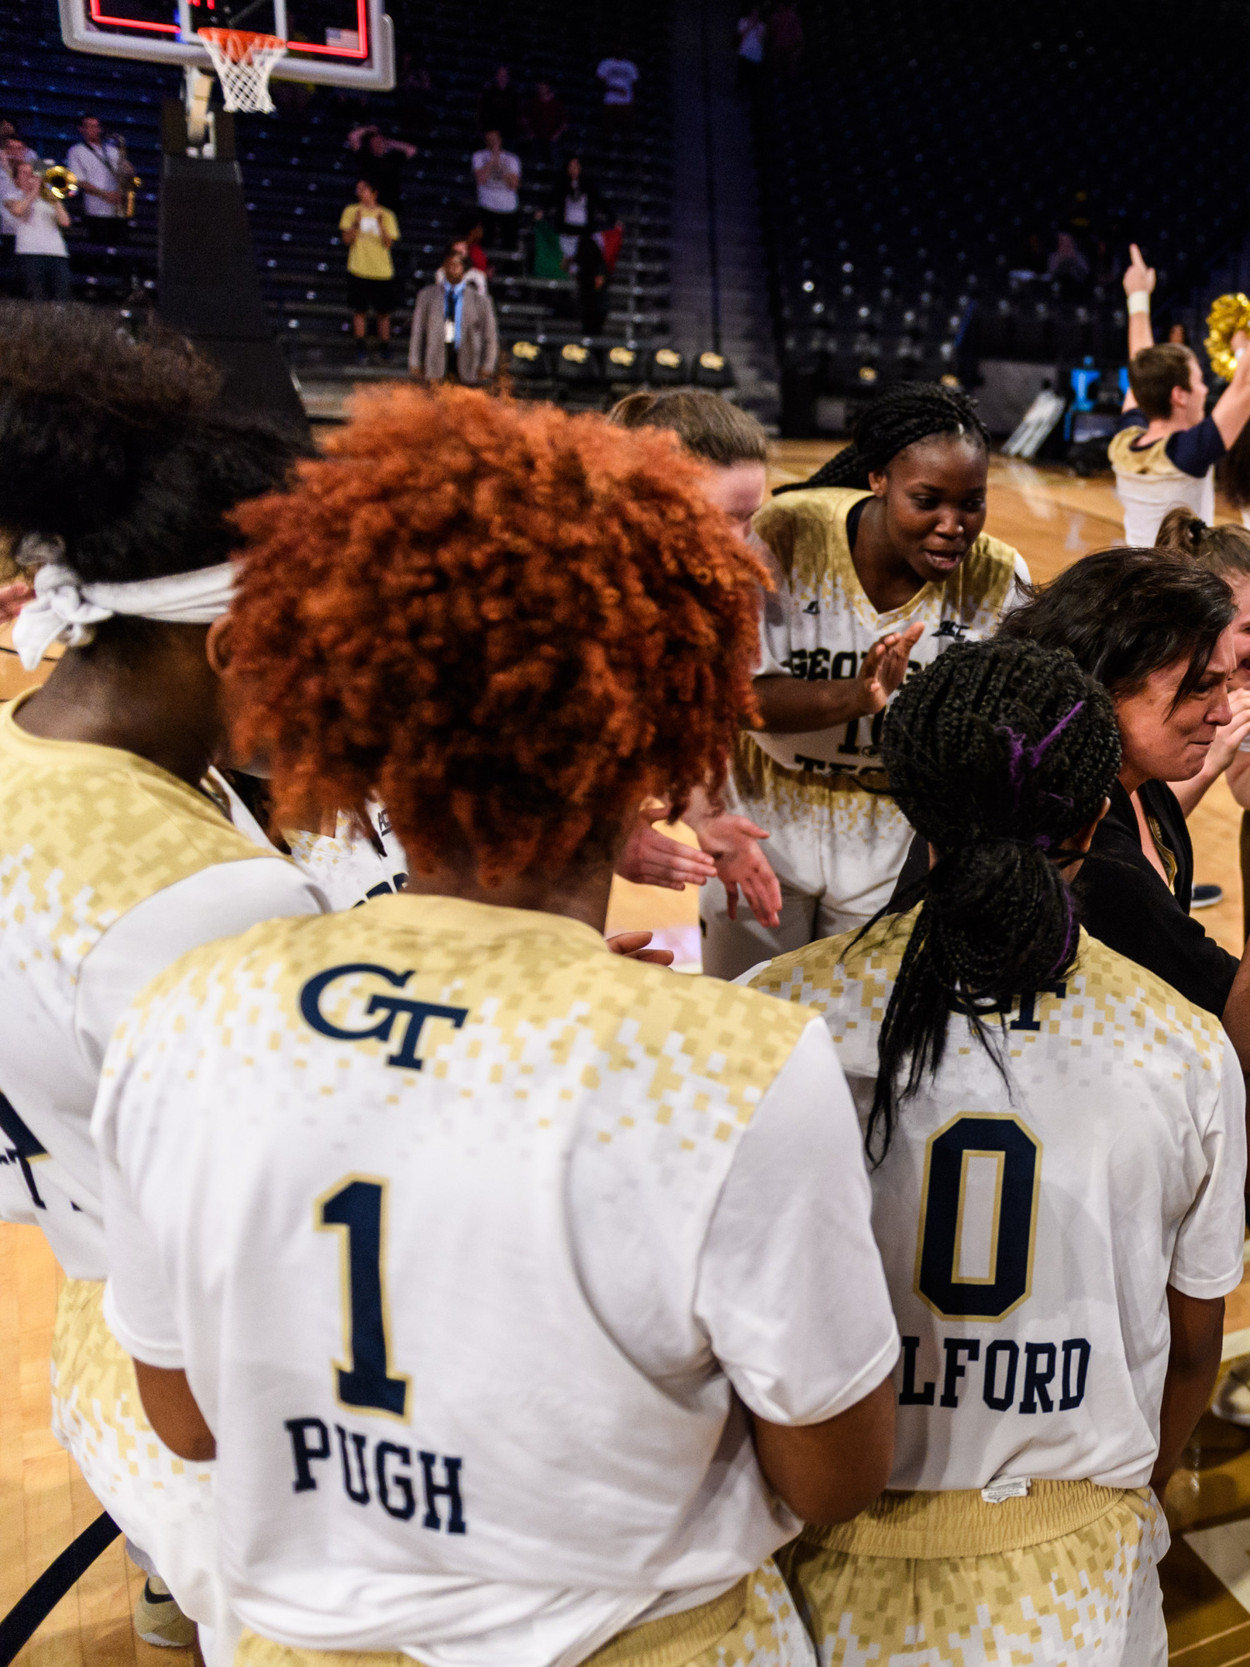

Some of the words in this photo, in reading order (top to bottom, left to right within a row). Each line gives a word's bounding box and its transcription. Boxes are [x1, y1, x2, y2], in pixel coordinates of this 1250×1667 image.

[299, 963, 470, 1071] GT
[913, 1111, 1043, 1323] 0
[314, 1171, 413, 1426] 1
[898, 1336, 1091, 1415] LFORD
[283, 1417, 467, 1535] PUGH
